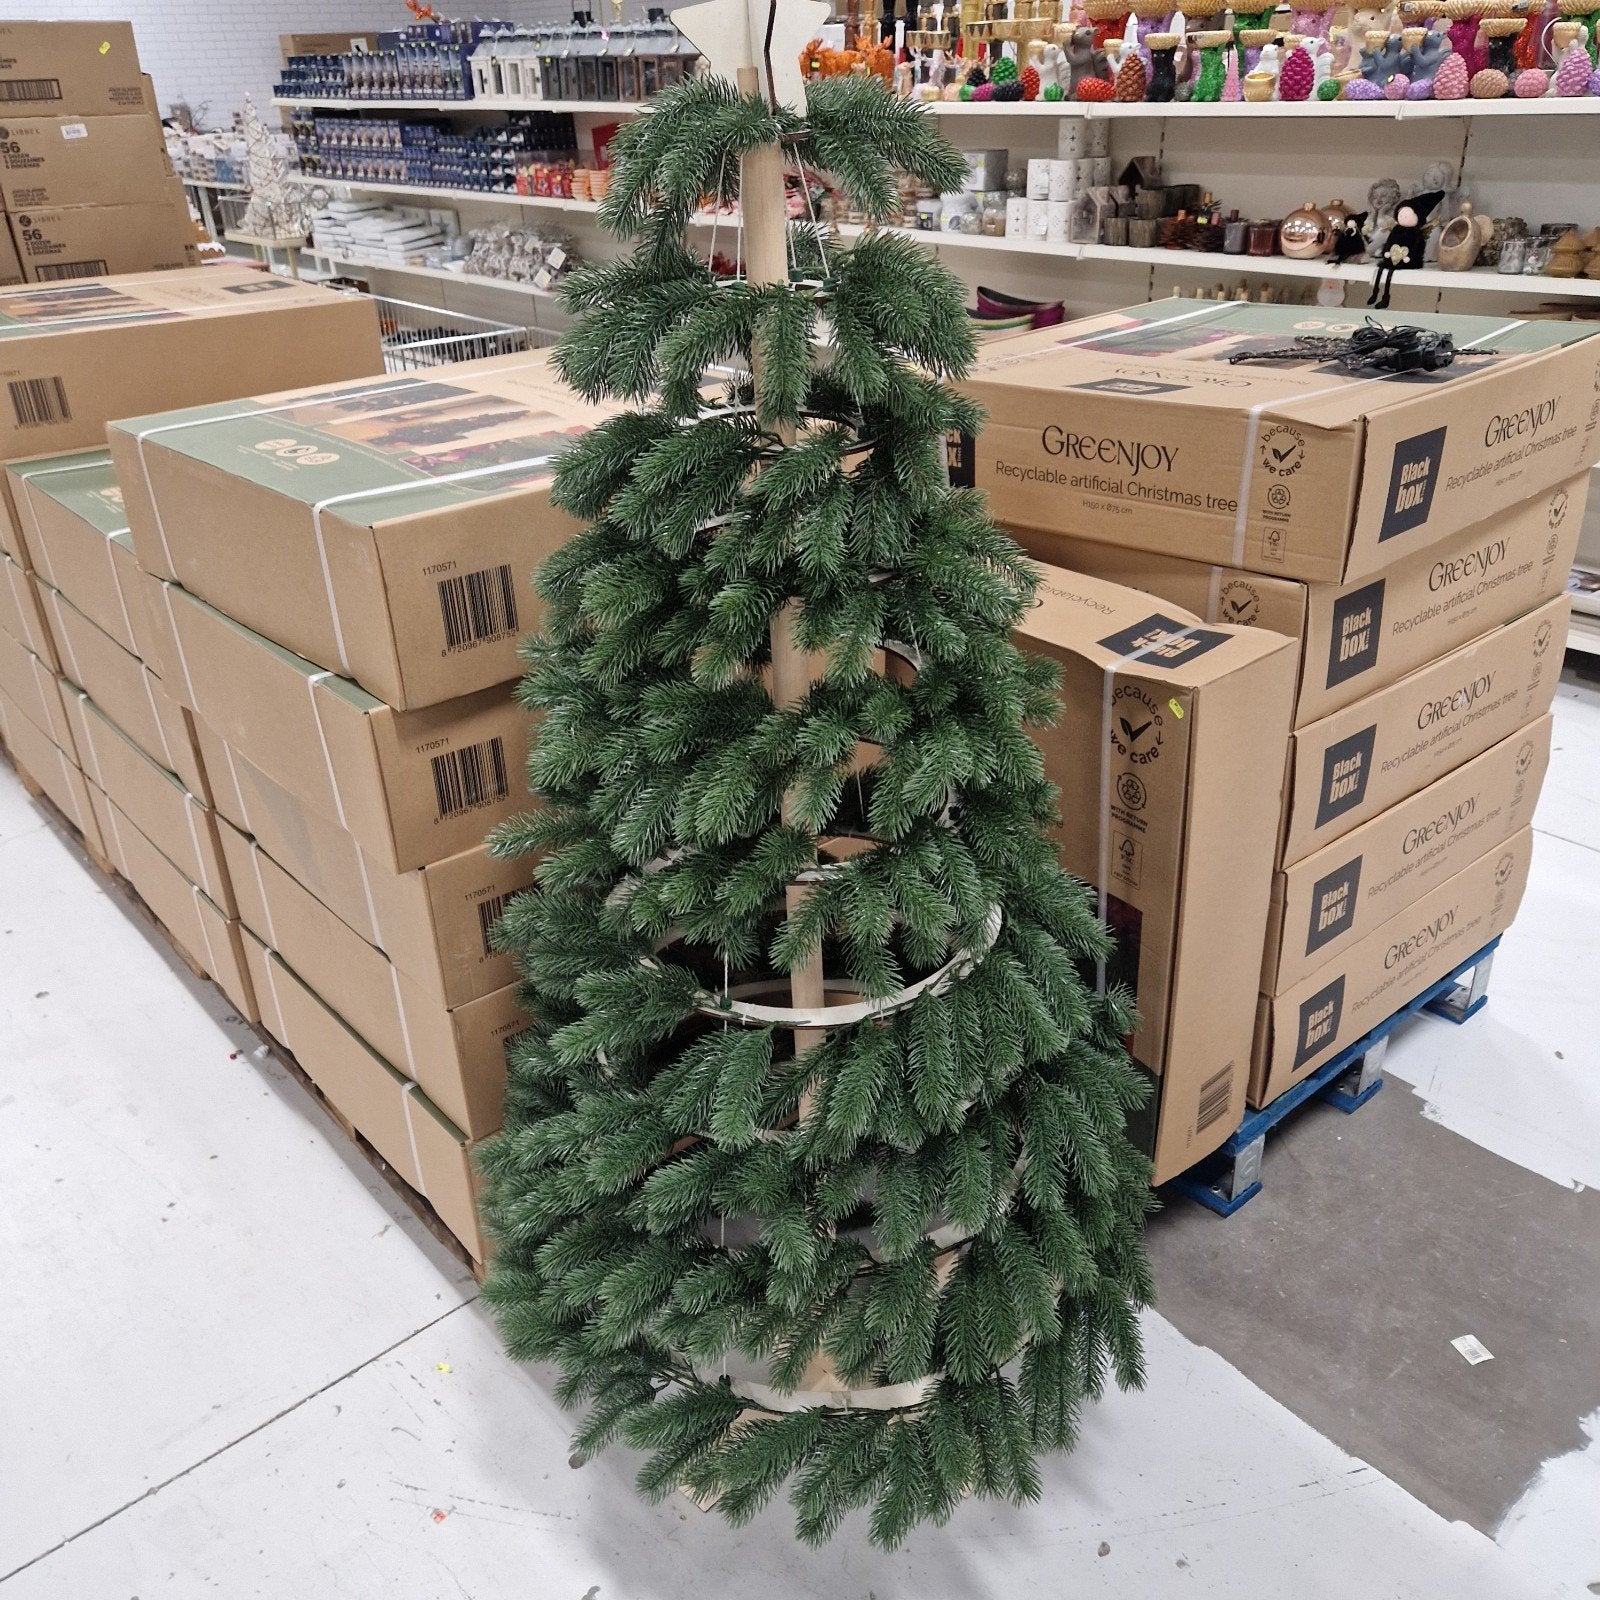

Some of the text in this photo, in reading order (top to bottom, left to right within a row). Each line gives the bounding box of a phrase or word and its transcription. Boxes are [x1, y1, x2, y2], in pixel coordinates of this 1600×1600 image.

[22, 229, 43, 241] 56
[1261, 425, 1305, 447] because
[1484, 396, 1561, 447] GREENJOY
[1042, 425, 1179, 476] GREENJOY
[1445, 462, 1497, 491] Recyclable
[1493, 446, 1523, 471] artificial
[1524, 433, 1562, 457] Christmas
[1562, 425, 1578, 441] tree
[1262, 457, 1302, 477] we care
[1400, 456, 1431, 485] Black
[996, 461, 1238, 512] Recyclable artificial Christmas tree
[422, 560, 457, 576] 1170571
[1429, 537, 1511, 592] GREENJOY
[1221, 580, 1259, 602] because
[1392, 603, 1442, 637] Recyclable
[1442, 585, 1475, 612] artificial
[1476, 569, 1516, 597] Christmas
[1517, 560, 1534, 578] tree
[1342, 607, 1372, 635] Black
[1417, 670, 1496, 730] GREENJOY
[416, 737, 449, 754] 1170571
[1380, 742, 1429, 774] Recyclable
[1429, 724, 1461, 750] artificial
[1462, 699, 1501, 728] Christmas
[1500, 688, 1518, 705] tree
[1130, 745, 1159, 765] care
[1333, 750, 1363, 776] Black
[1402, 792, 1481, 855] GREENJOY
[1367, 864, 1413, 899] Recyclable
[1415, 845, 1446, 870] artificial
[1447, 818, 1486, 848] Christmas
[464, 884, 496, 901] 1170571
[1321, 881, 1350, 908] Black
[1384, 904, 1461, 970] GREENJOY
[1351, 975, 1398, 1014] Recyclable
[490, 1019, 519, 1037] 1170571
[1308, 1000, 1335, 1030] Black
